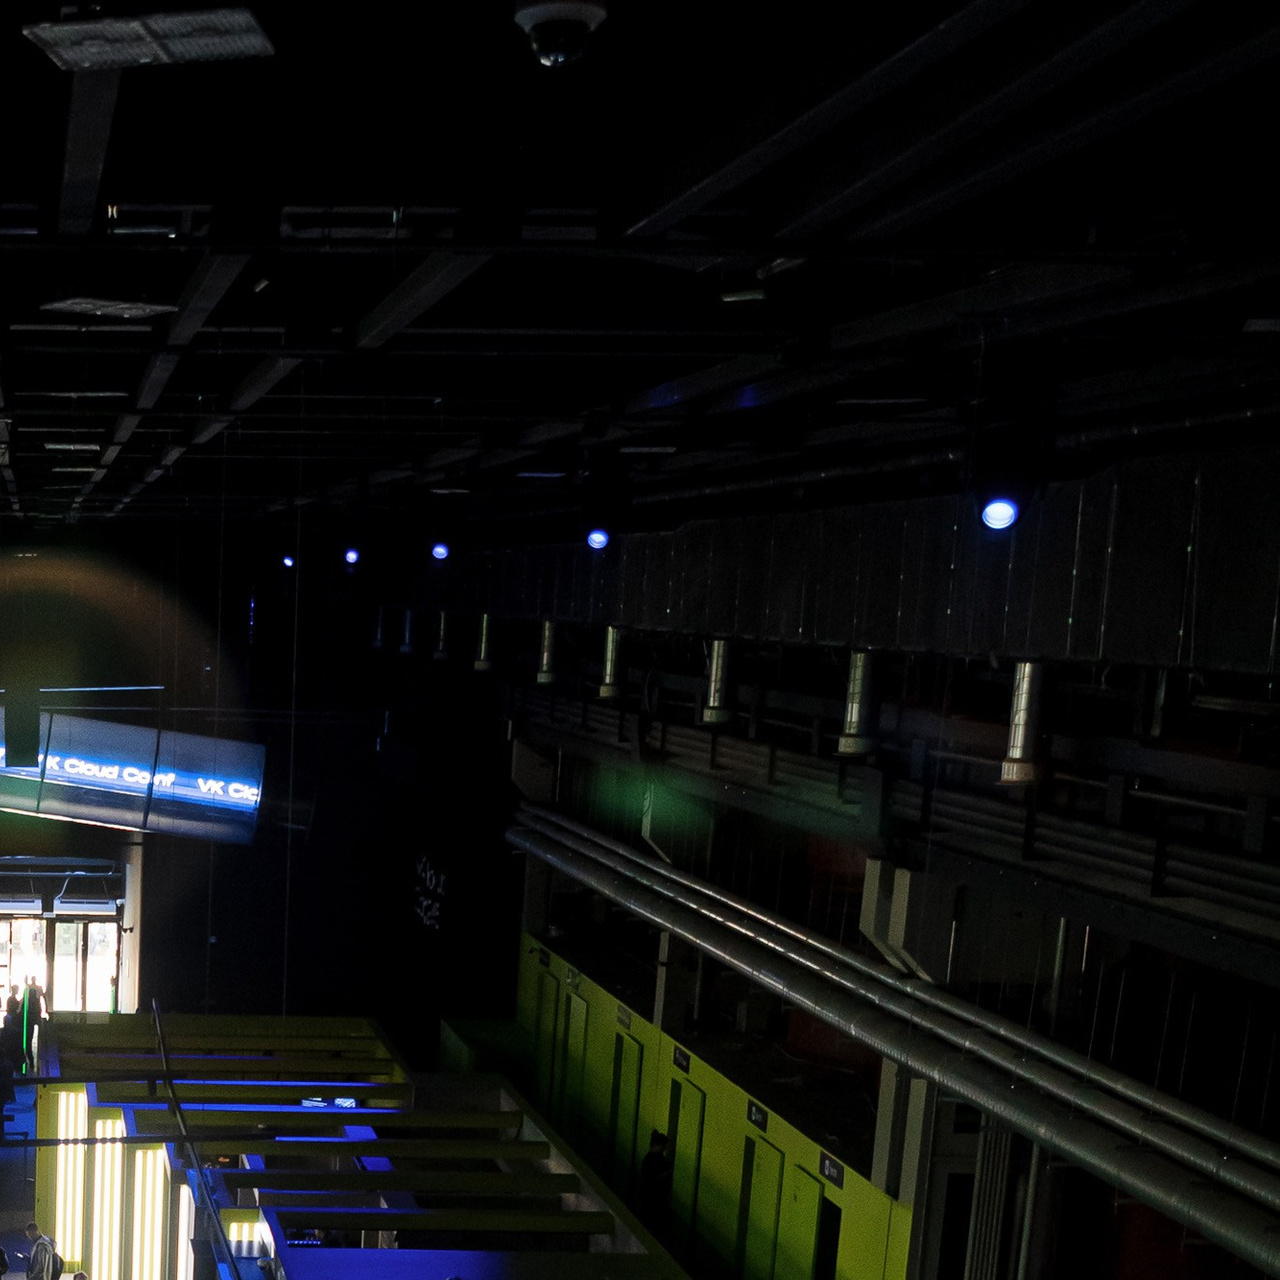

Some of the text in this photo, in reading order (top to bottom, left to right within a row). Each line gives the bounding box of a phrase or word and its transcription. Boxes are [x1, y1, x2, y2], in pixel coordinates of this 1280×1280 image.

[64, 759, 119, 780] Cloud
[122, 766, 176, 787] Conf
[197, 777, 225, 796] VK
